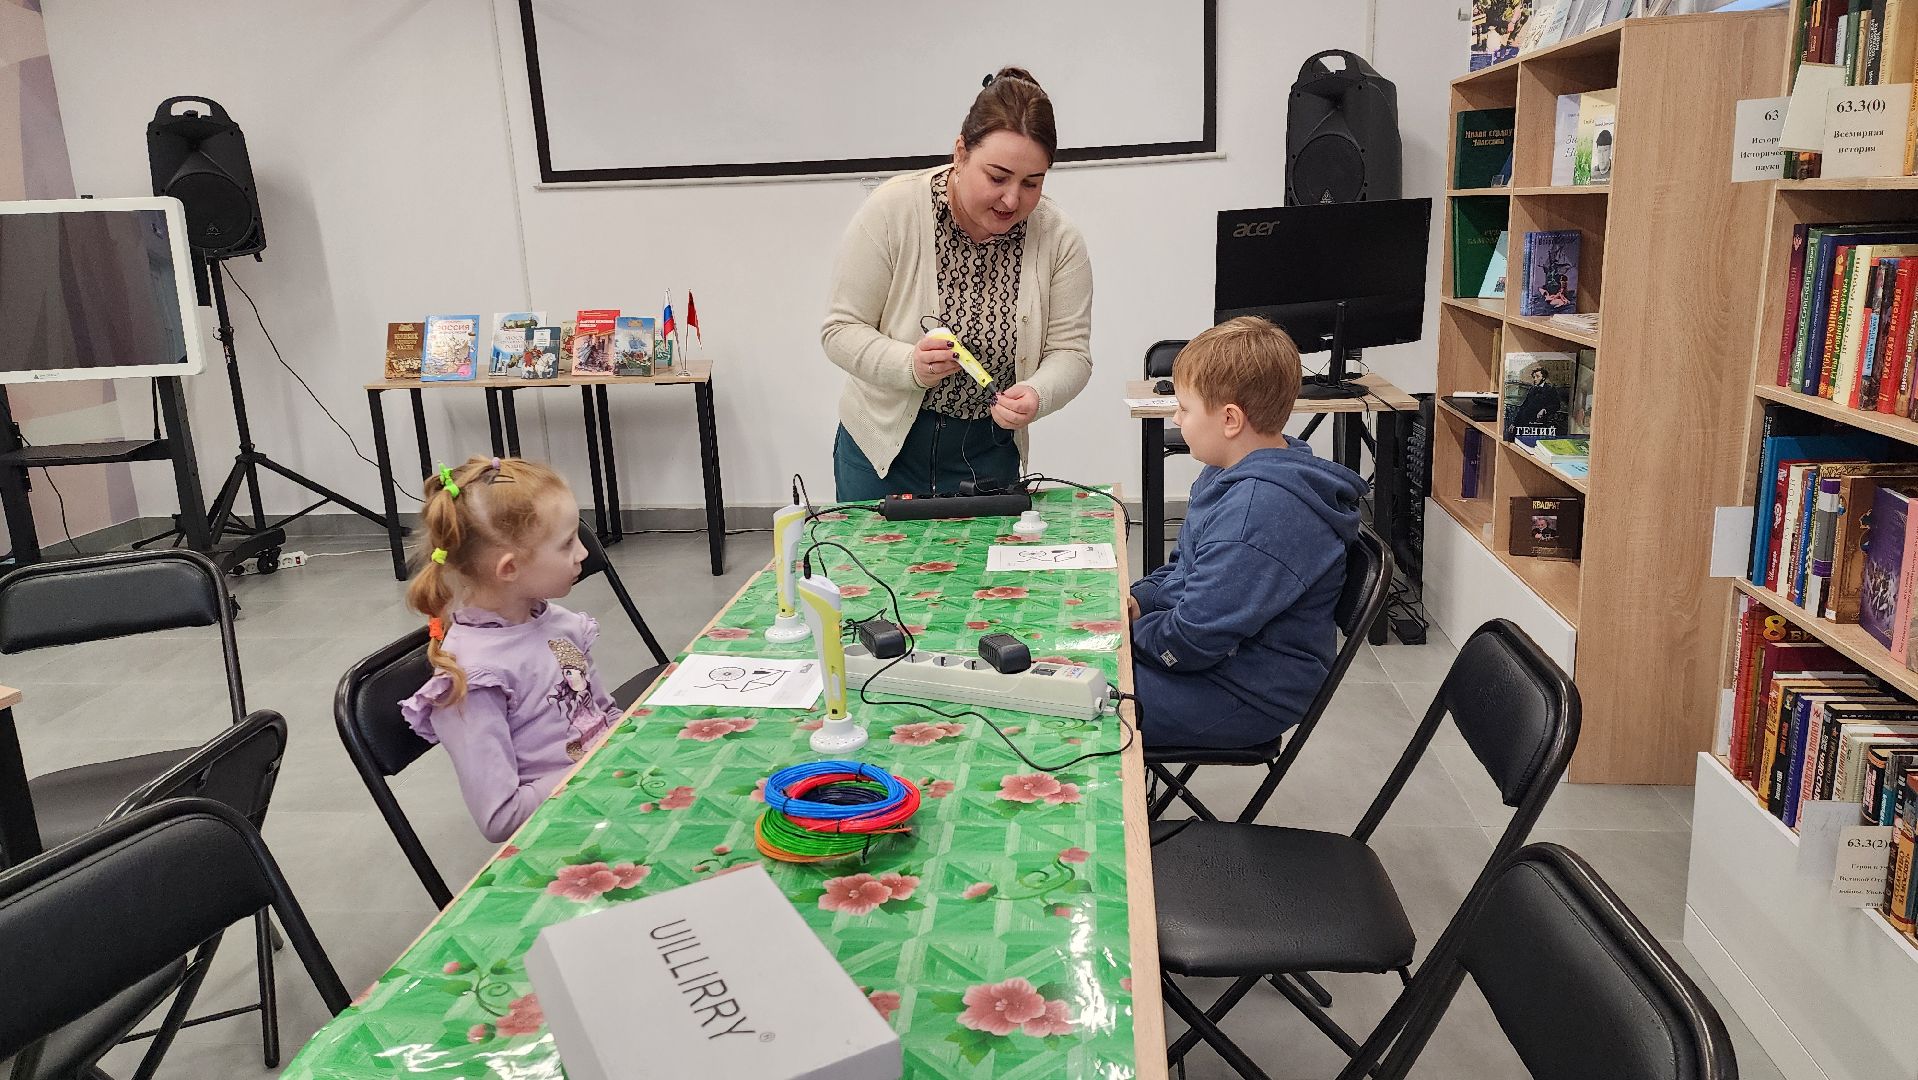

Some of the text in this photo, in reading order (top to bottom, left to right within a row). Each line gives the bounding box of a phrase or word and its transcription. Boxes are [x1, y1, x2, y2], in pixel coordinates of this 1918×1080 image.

[1836, 98, 1886, 114] 63.3(0)
[1764, 109, 1780, 122] 63
[1834, 129, 1885, 140] Всемирная
[1751, 136, 1781, 145] Истори
[1740, 150, 1786, 160] Историчес
[1838, 145, 1877, 155] история
[1755, 164, 1781, 172] науки
[1232, 220, 1280, 238] acer
[1883, 288, 1902, 379] РУССКАЯ ИСТОРИЯ
[1515, 426, 1557, 437] ГЕНИЙ
[1532, 500, 1561, 510] КВАДРАТ
[1847, 838, 1892, 850] 63.3(2)
[649, 918, 756, 1041] UILLIRRY
